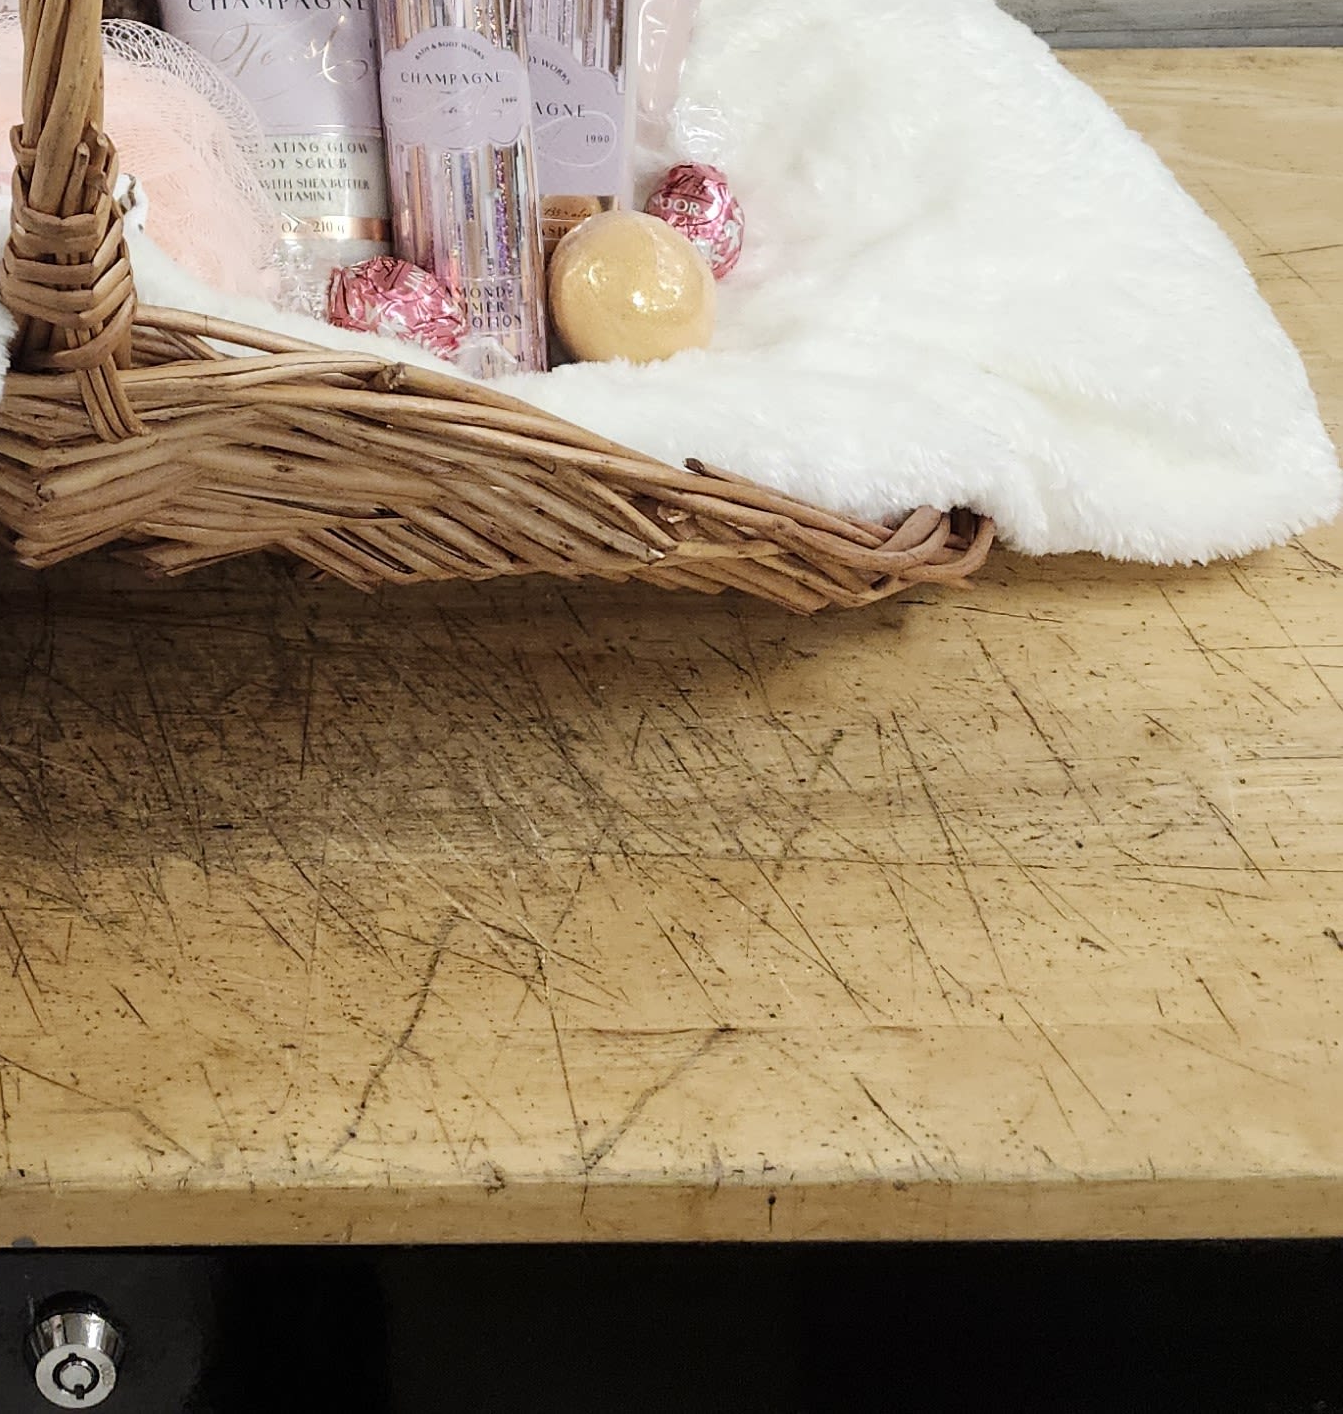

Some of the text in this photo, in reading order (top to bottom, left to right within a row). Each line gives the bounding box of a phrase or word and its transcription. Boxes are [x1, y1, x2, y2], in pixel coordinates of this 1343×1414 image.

[400, 71, 504, 86] CHAMPAGNE
[326, 141, 369, 154] GLOW
[295, 156, 348, 169] SCRUB
[296, 177, 327, 189] SHEA
[274, 191, 325, 202] VITAMIN
[313, 220, 333, 233] 210
